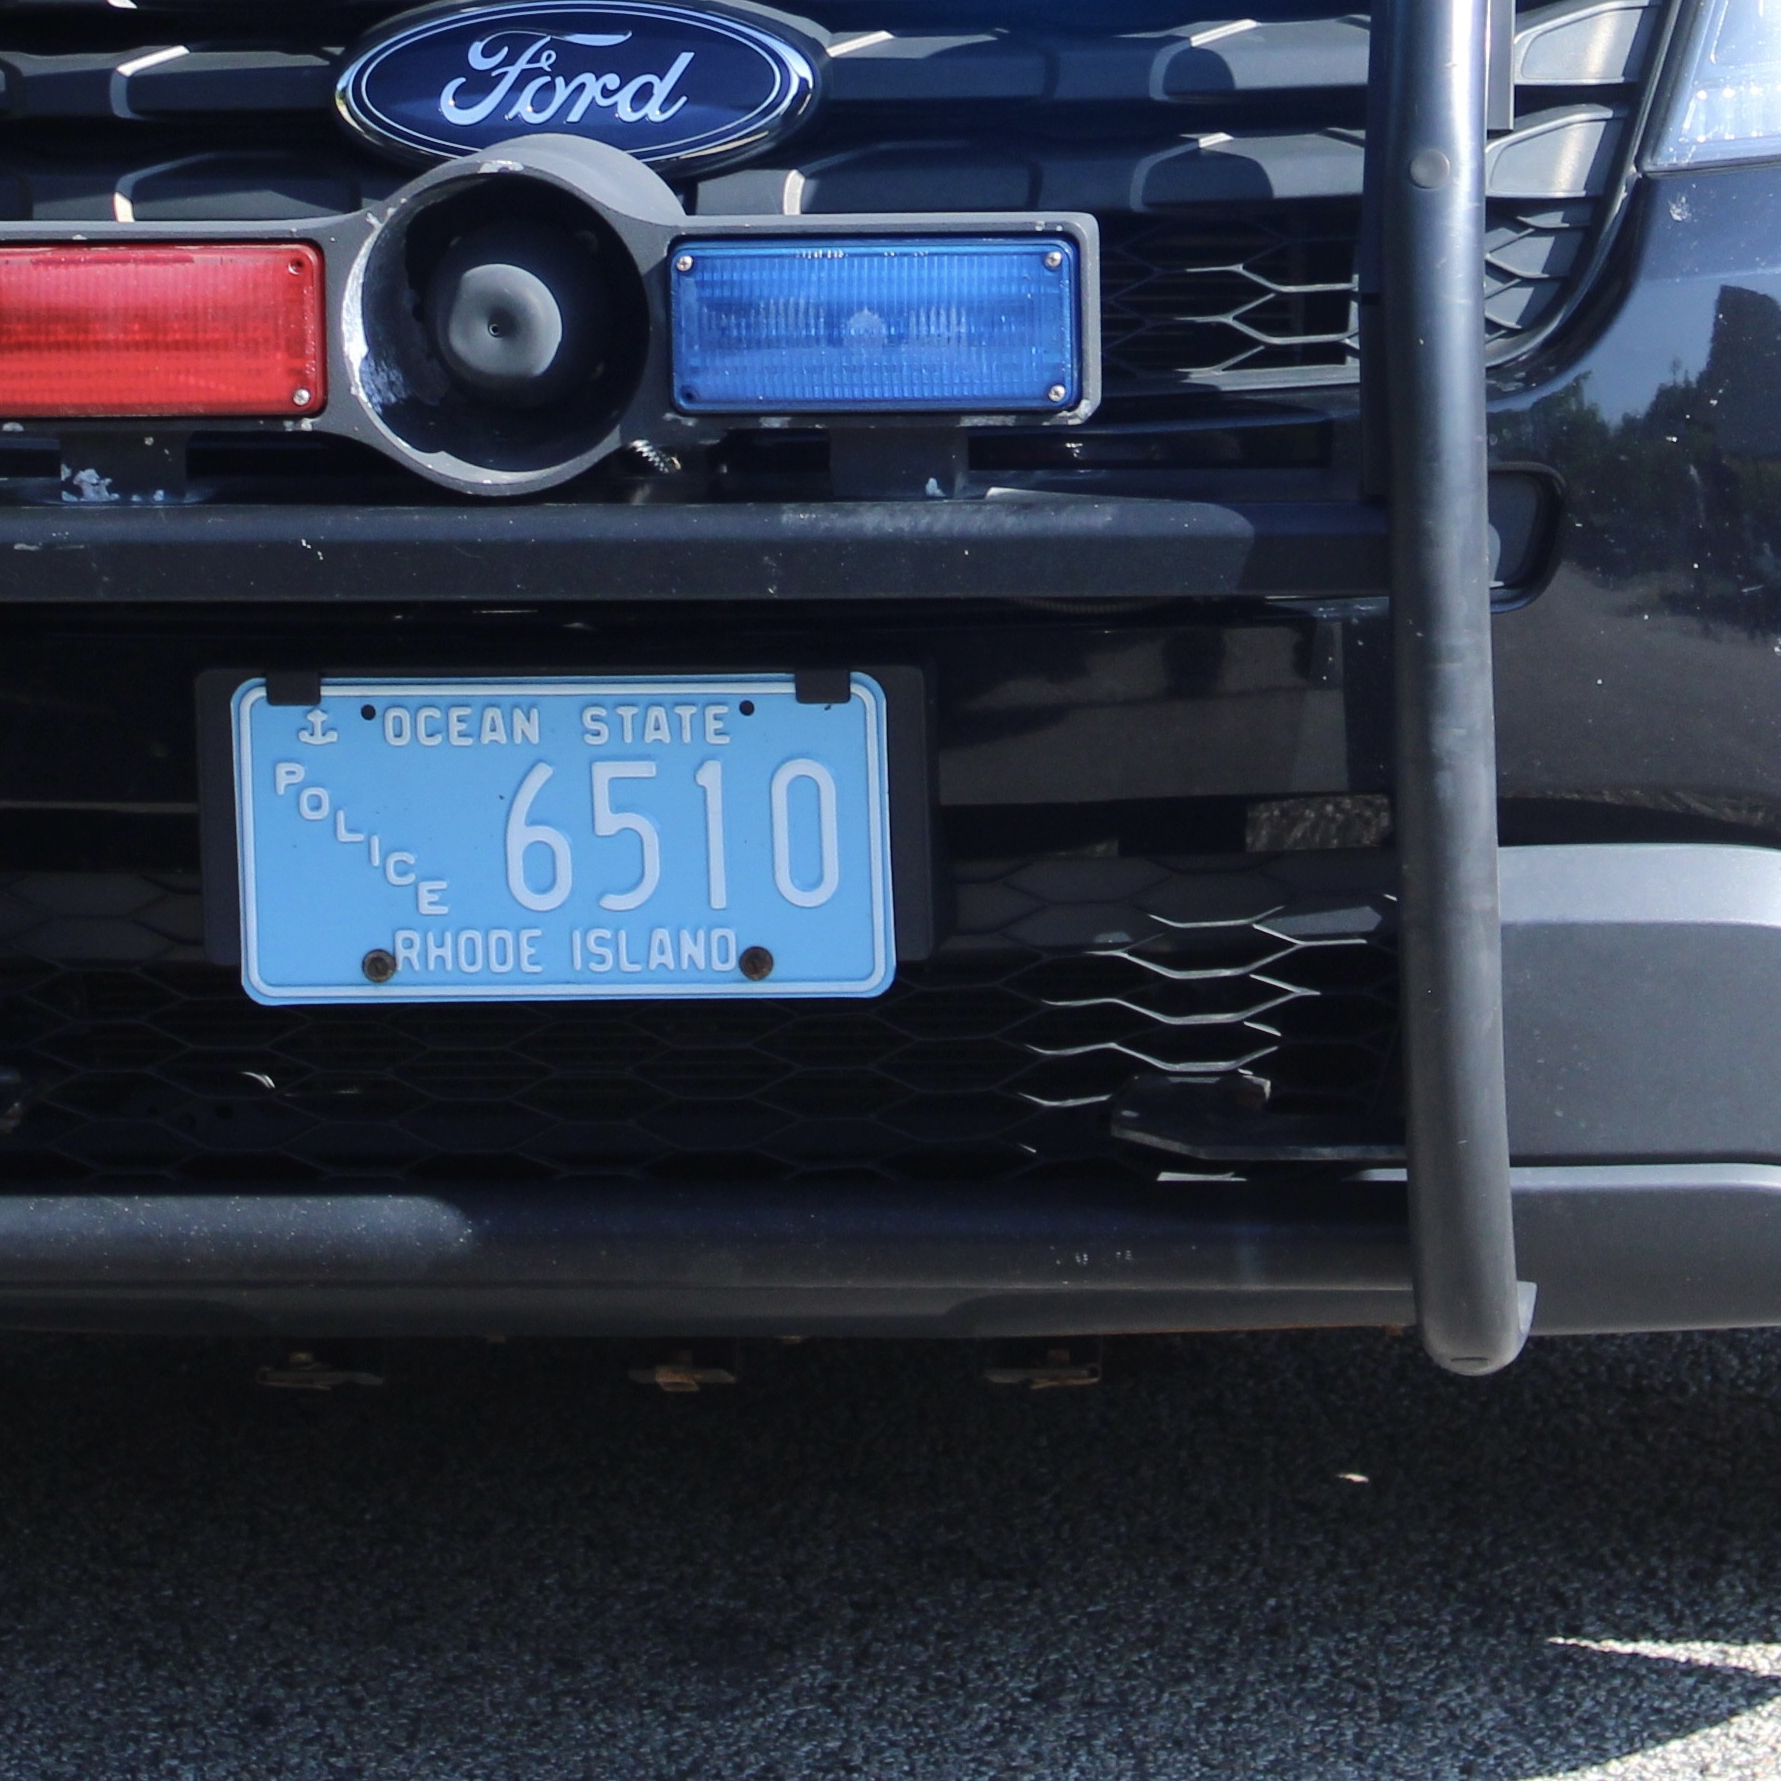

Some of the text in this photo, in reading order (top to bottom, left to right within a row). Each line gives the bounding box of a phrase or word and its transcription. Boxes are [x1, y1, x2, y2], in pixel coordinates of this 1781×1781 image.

[438, 29, 696, 125] Ford
[384, 704, 731, 746] OCEAN STATE
[274, 761, 450, 915] POLICE
[505, 757, 840, 912] 6510
[394, 927, 737, 973] RHODE ISLAND
